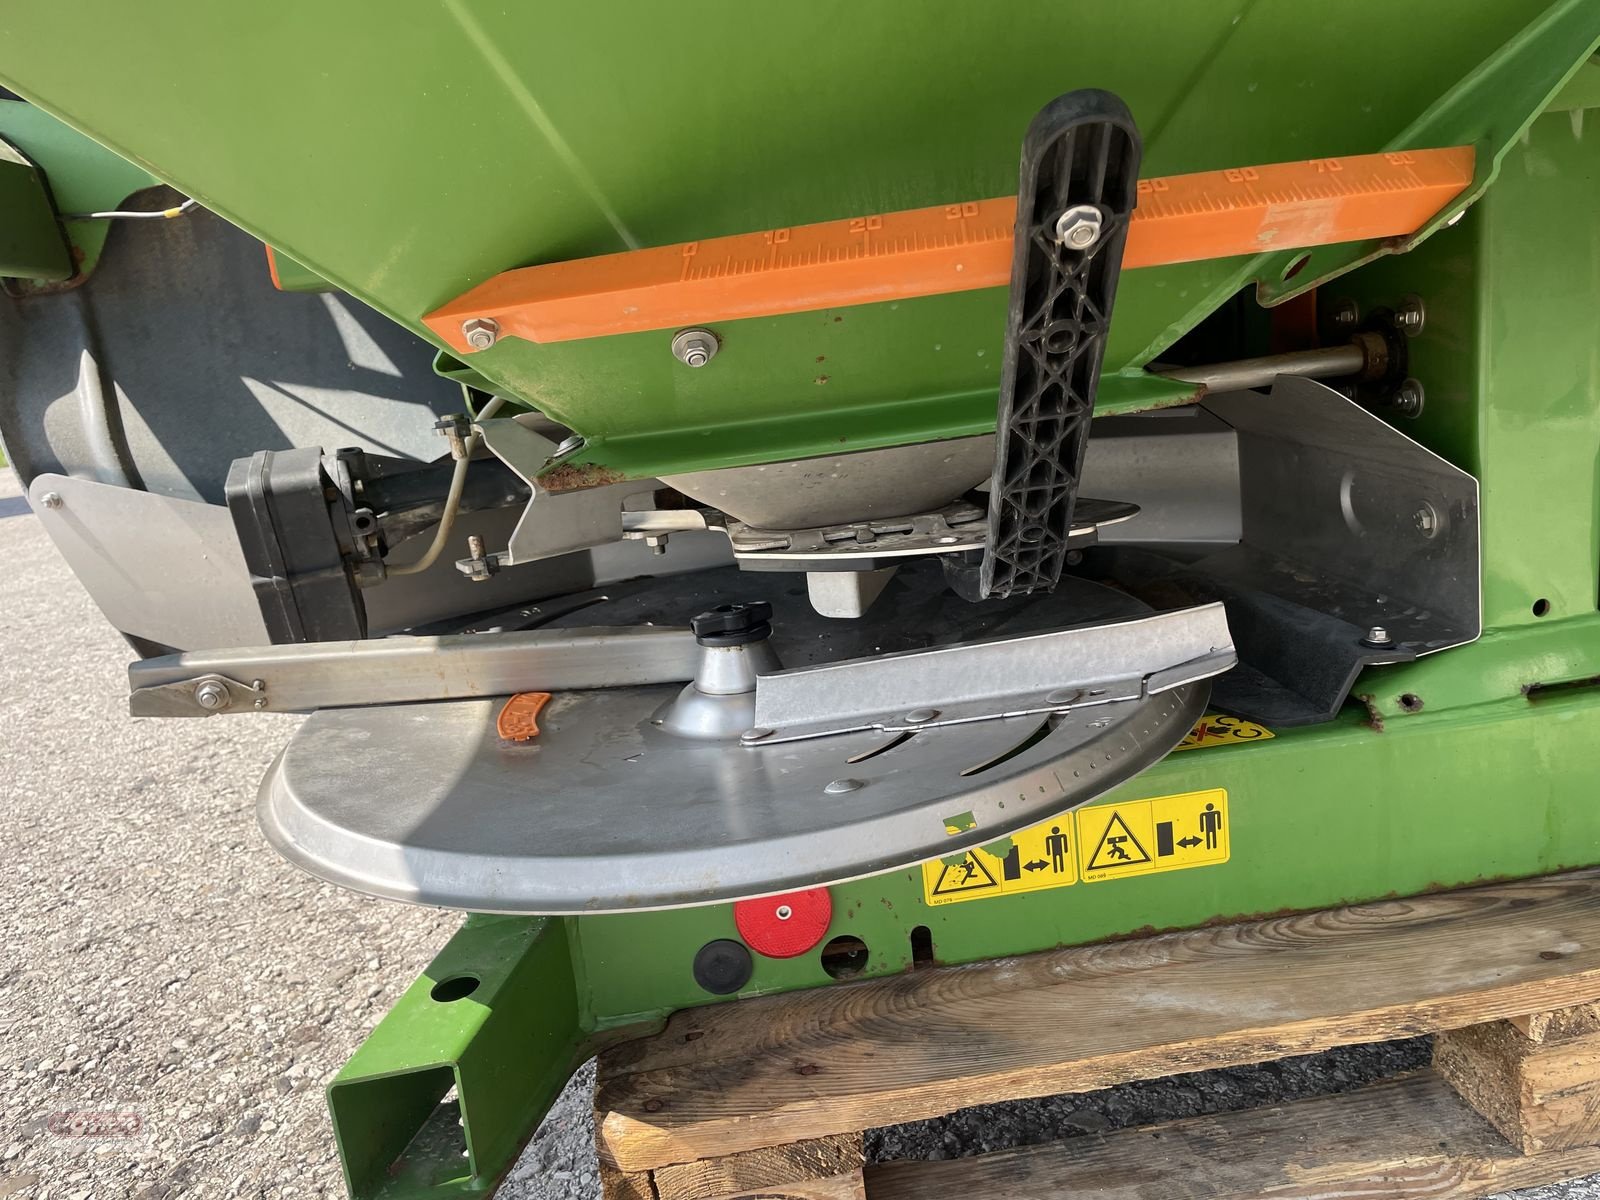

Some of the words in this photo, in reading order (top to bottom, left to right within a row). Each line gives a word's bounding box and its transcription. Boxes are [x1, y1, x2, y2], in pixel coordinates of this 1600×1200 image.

[682, 242, 699, 257] 0
[764, 229, 791, 245] 10
[849, 216, 882, 233] 20
[945, 202, 979, 220] 30
[1136, 179, 1169, 193] 50
[1224, 168, 1259, 183] 60
[1309, 159, 1343, 173] 70
